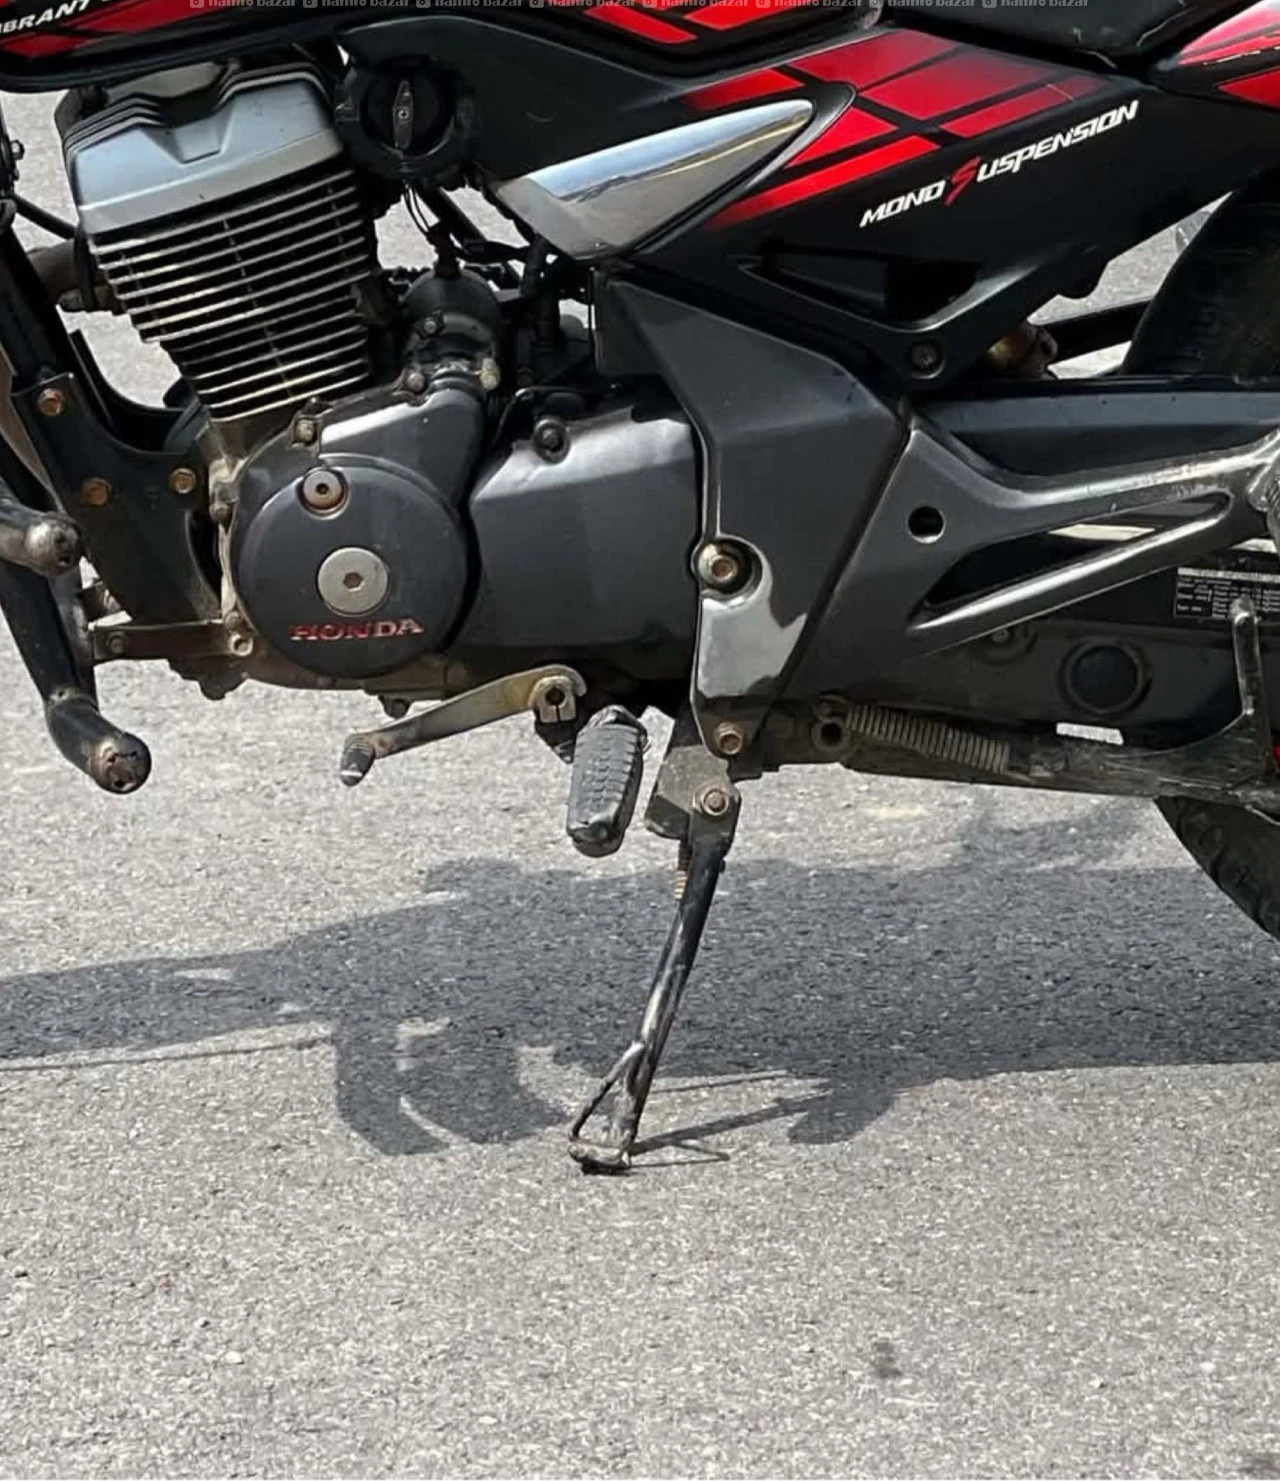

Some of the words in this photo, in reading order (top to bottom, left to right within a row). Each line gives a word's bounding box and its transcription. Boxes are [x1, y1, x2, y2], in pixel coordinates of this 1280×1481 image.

[859, 179, 946, 228] MONO
[946, 100, 1140, 207] SUSPENSION
[287, 618, 425, 641] HONDA
